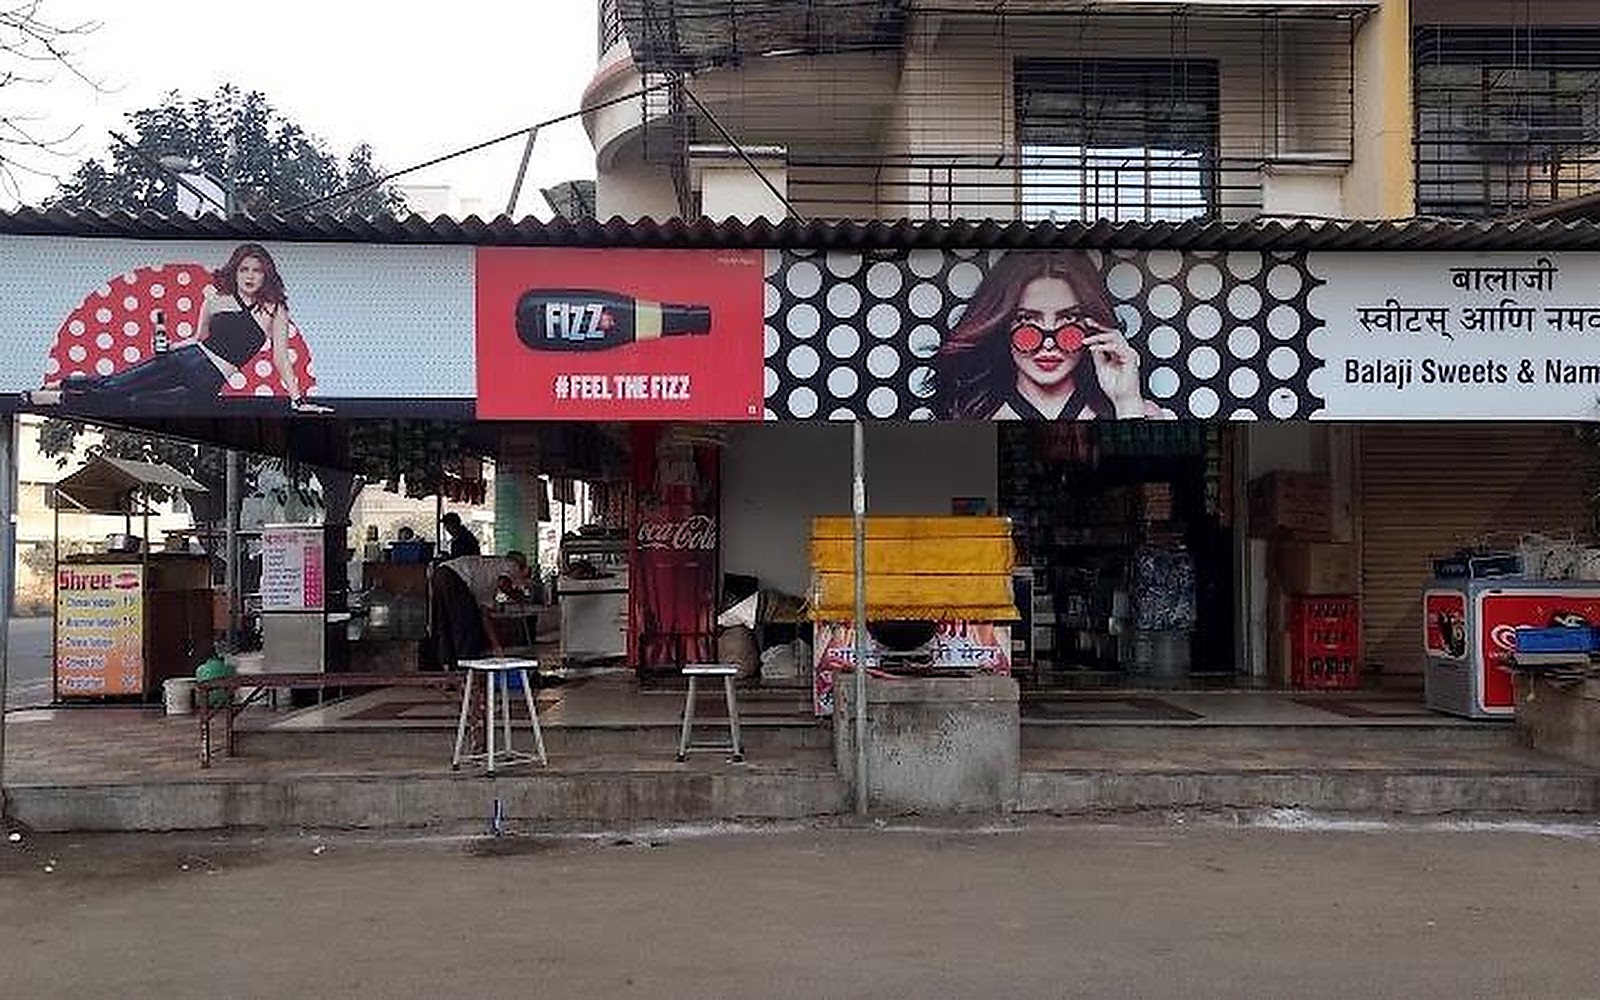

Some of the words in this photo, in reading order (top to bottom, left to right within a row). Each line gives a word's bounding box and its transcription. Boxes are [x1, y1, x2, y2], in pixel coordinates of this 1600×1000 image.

[1450, 258, 1558, 292] बालाजी
[546, 303, 605, 340] FIZZ
[1357, 299, 1454, 341] स्वीटस्
[1460, 299, 1536, 332] आणि
[555, 375, 613, 399] #FEEL
[613, 375, 649, 399] THE
[650, 375, 691, 399] FIZZ
[1345, 359, 1412, 390] Balaji
[1421, 359, 1508, 384] Sweets
[1516, 359, 1536, 384] &
[1545, 359, 1600, 384] Nam
[59, 569, 113, 591] Shree
